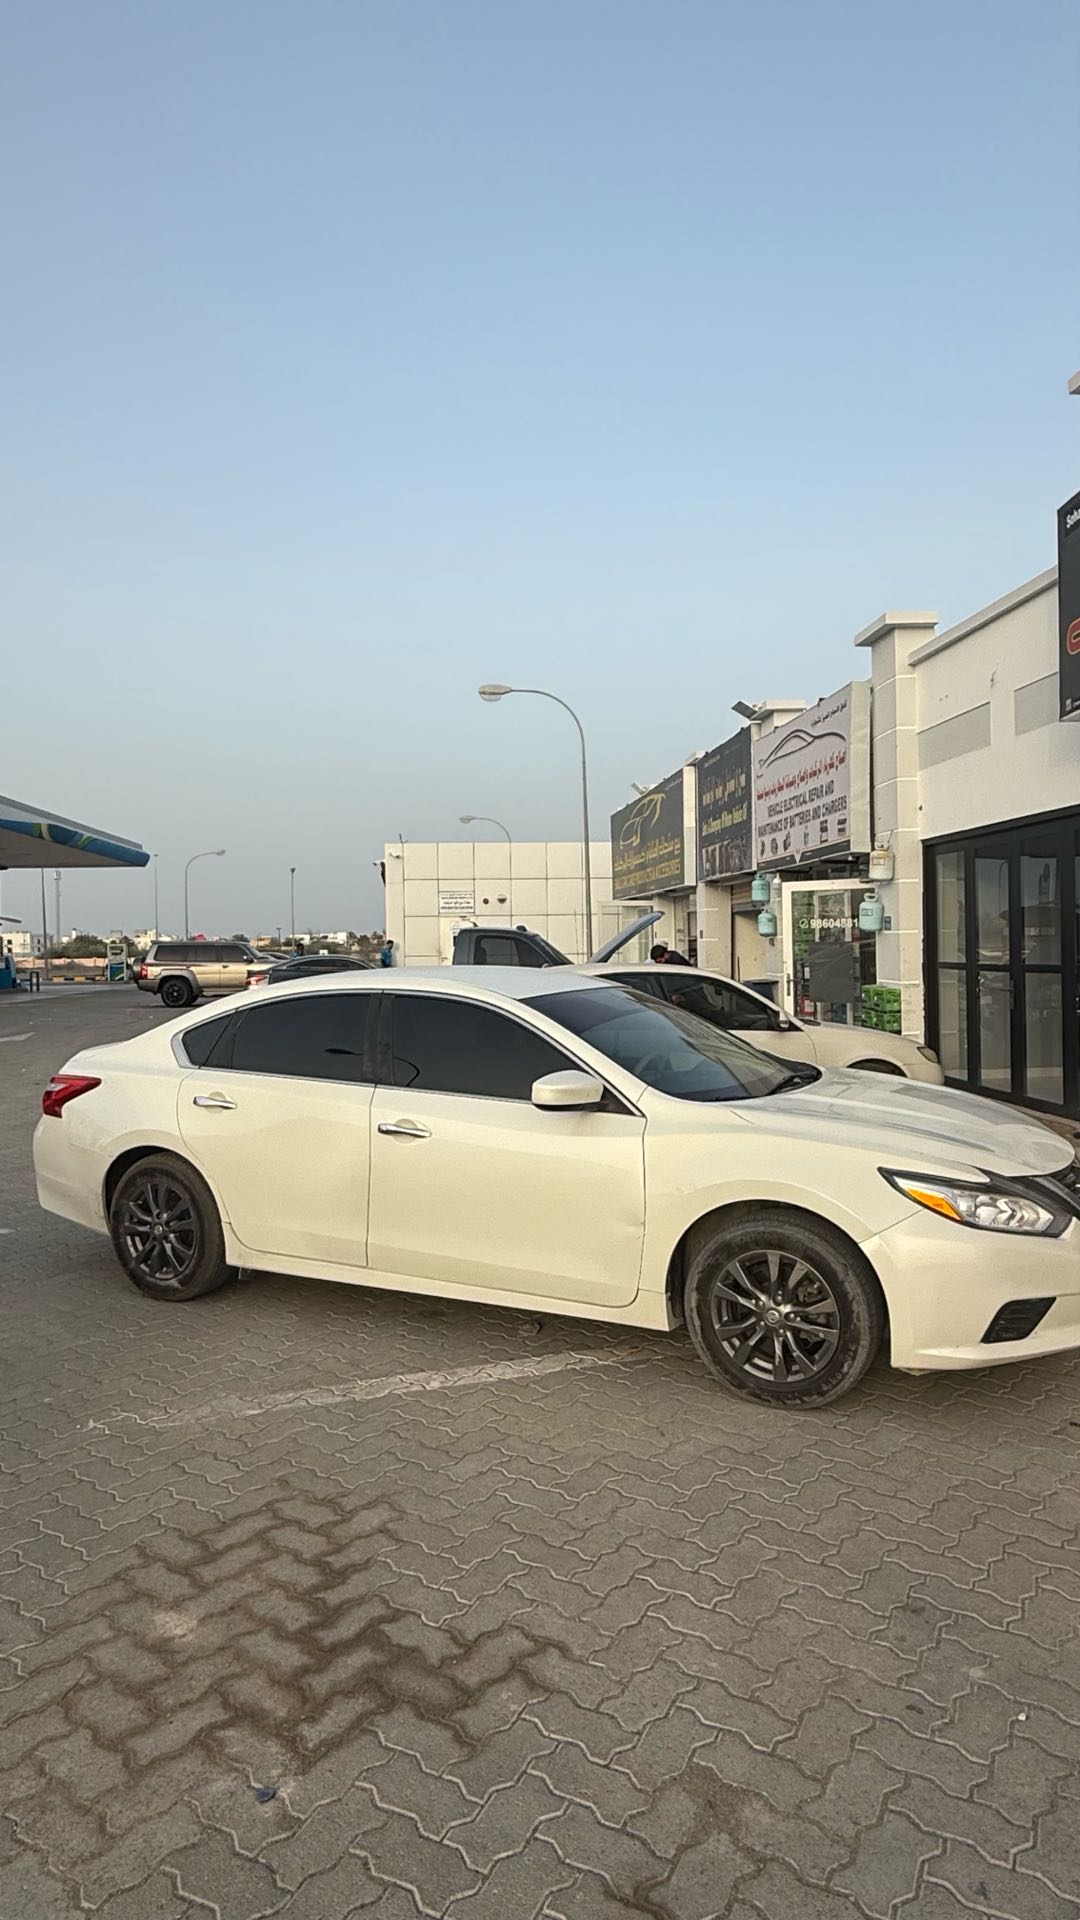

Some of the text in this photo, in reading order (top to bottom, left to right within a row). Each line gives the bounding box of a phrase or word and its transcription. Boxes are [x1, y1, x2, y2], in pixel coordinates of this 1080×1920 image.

[757, 819, 783, 837] MAINTENANCE
[783, 817, 789, 830] OF
[789, 809, 811, 828] BATTERIES
[811, 804, 821, 820] AND
[821, 794, 847, 817] CHARGERS
[767, 779, 835, 818] VEHICLE ELECTRICAL REPAIR AND
[810, 917, 858, 929] 98604881
